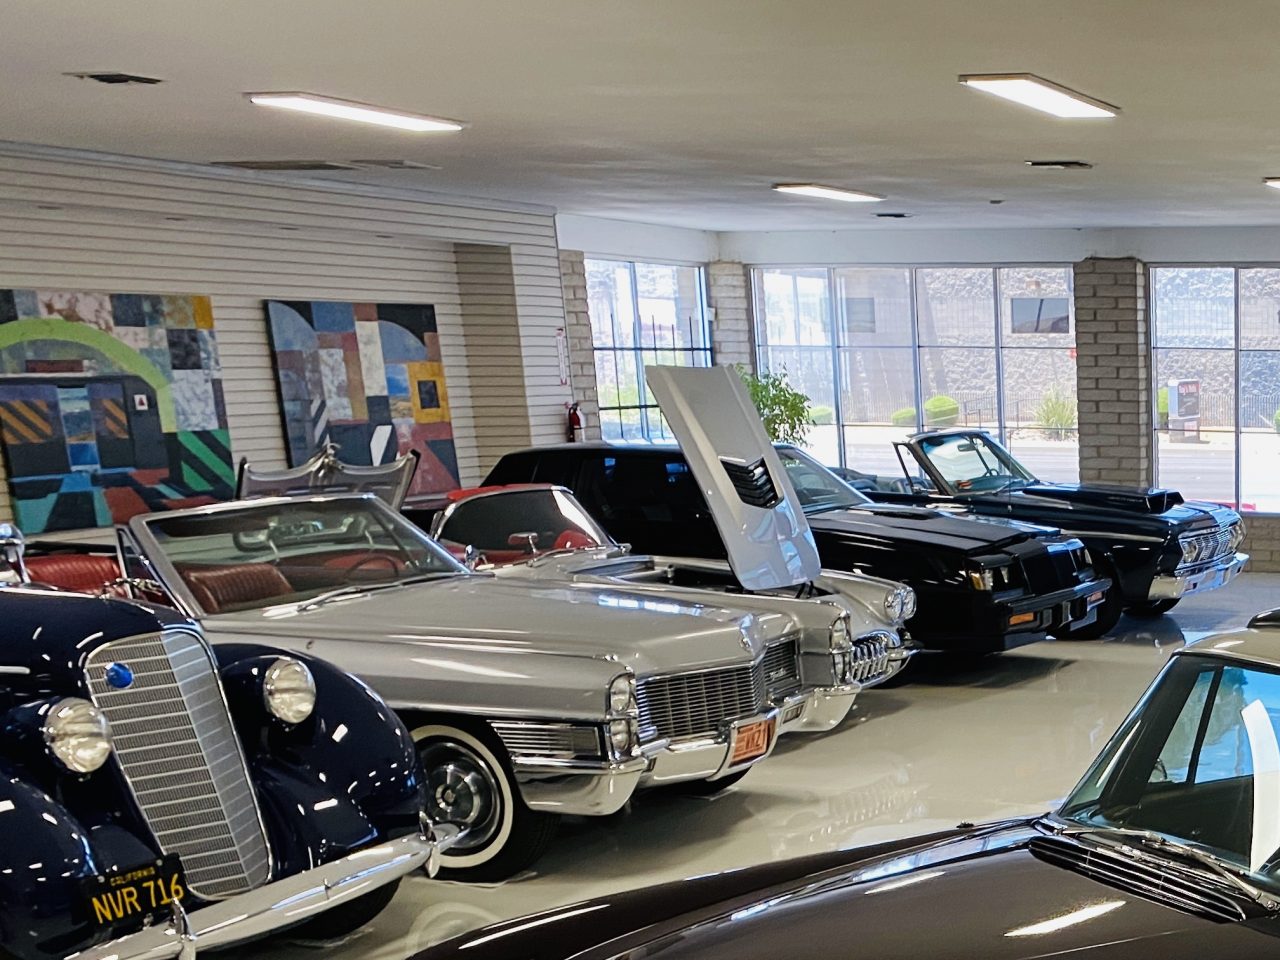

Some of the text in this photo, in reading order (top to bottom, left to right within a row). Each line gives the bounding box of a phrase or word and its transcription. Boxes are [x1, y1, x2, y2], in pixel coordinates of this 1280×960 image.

[110, 866, 156, 886] CALIFORNIA
[92, 873, 185, 925] NVR 716
